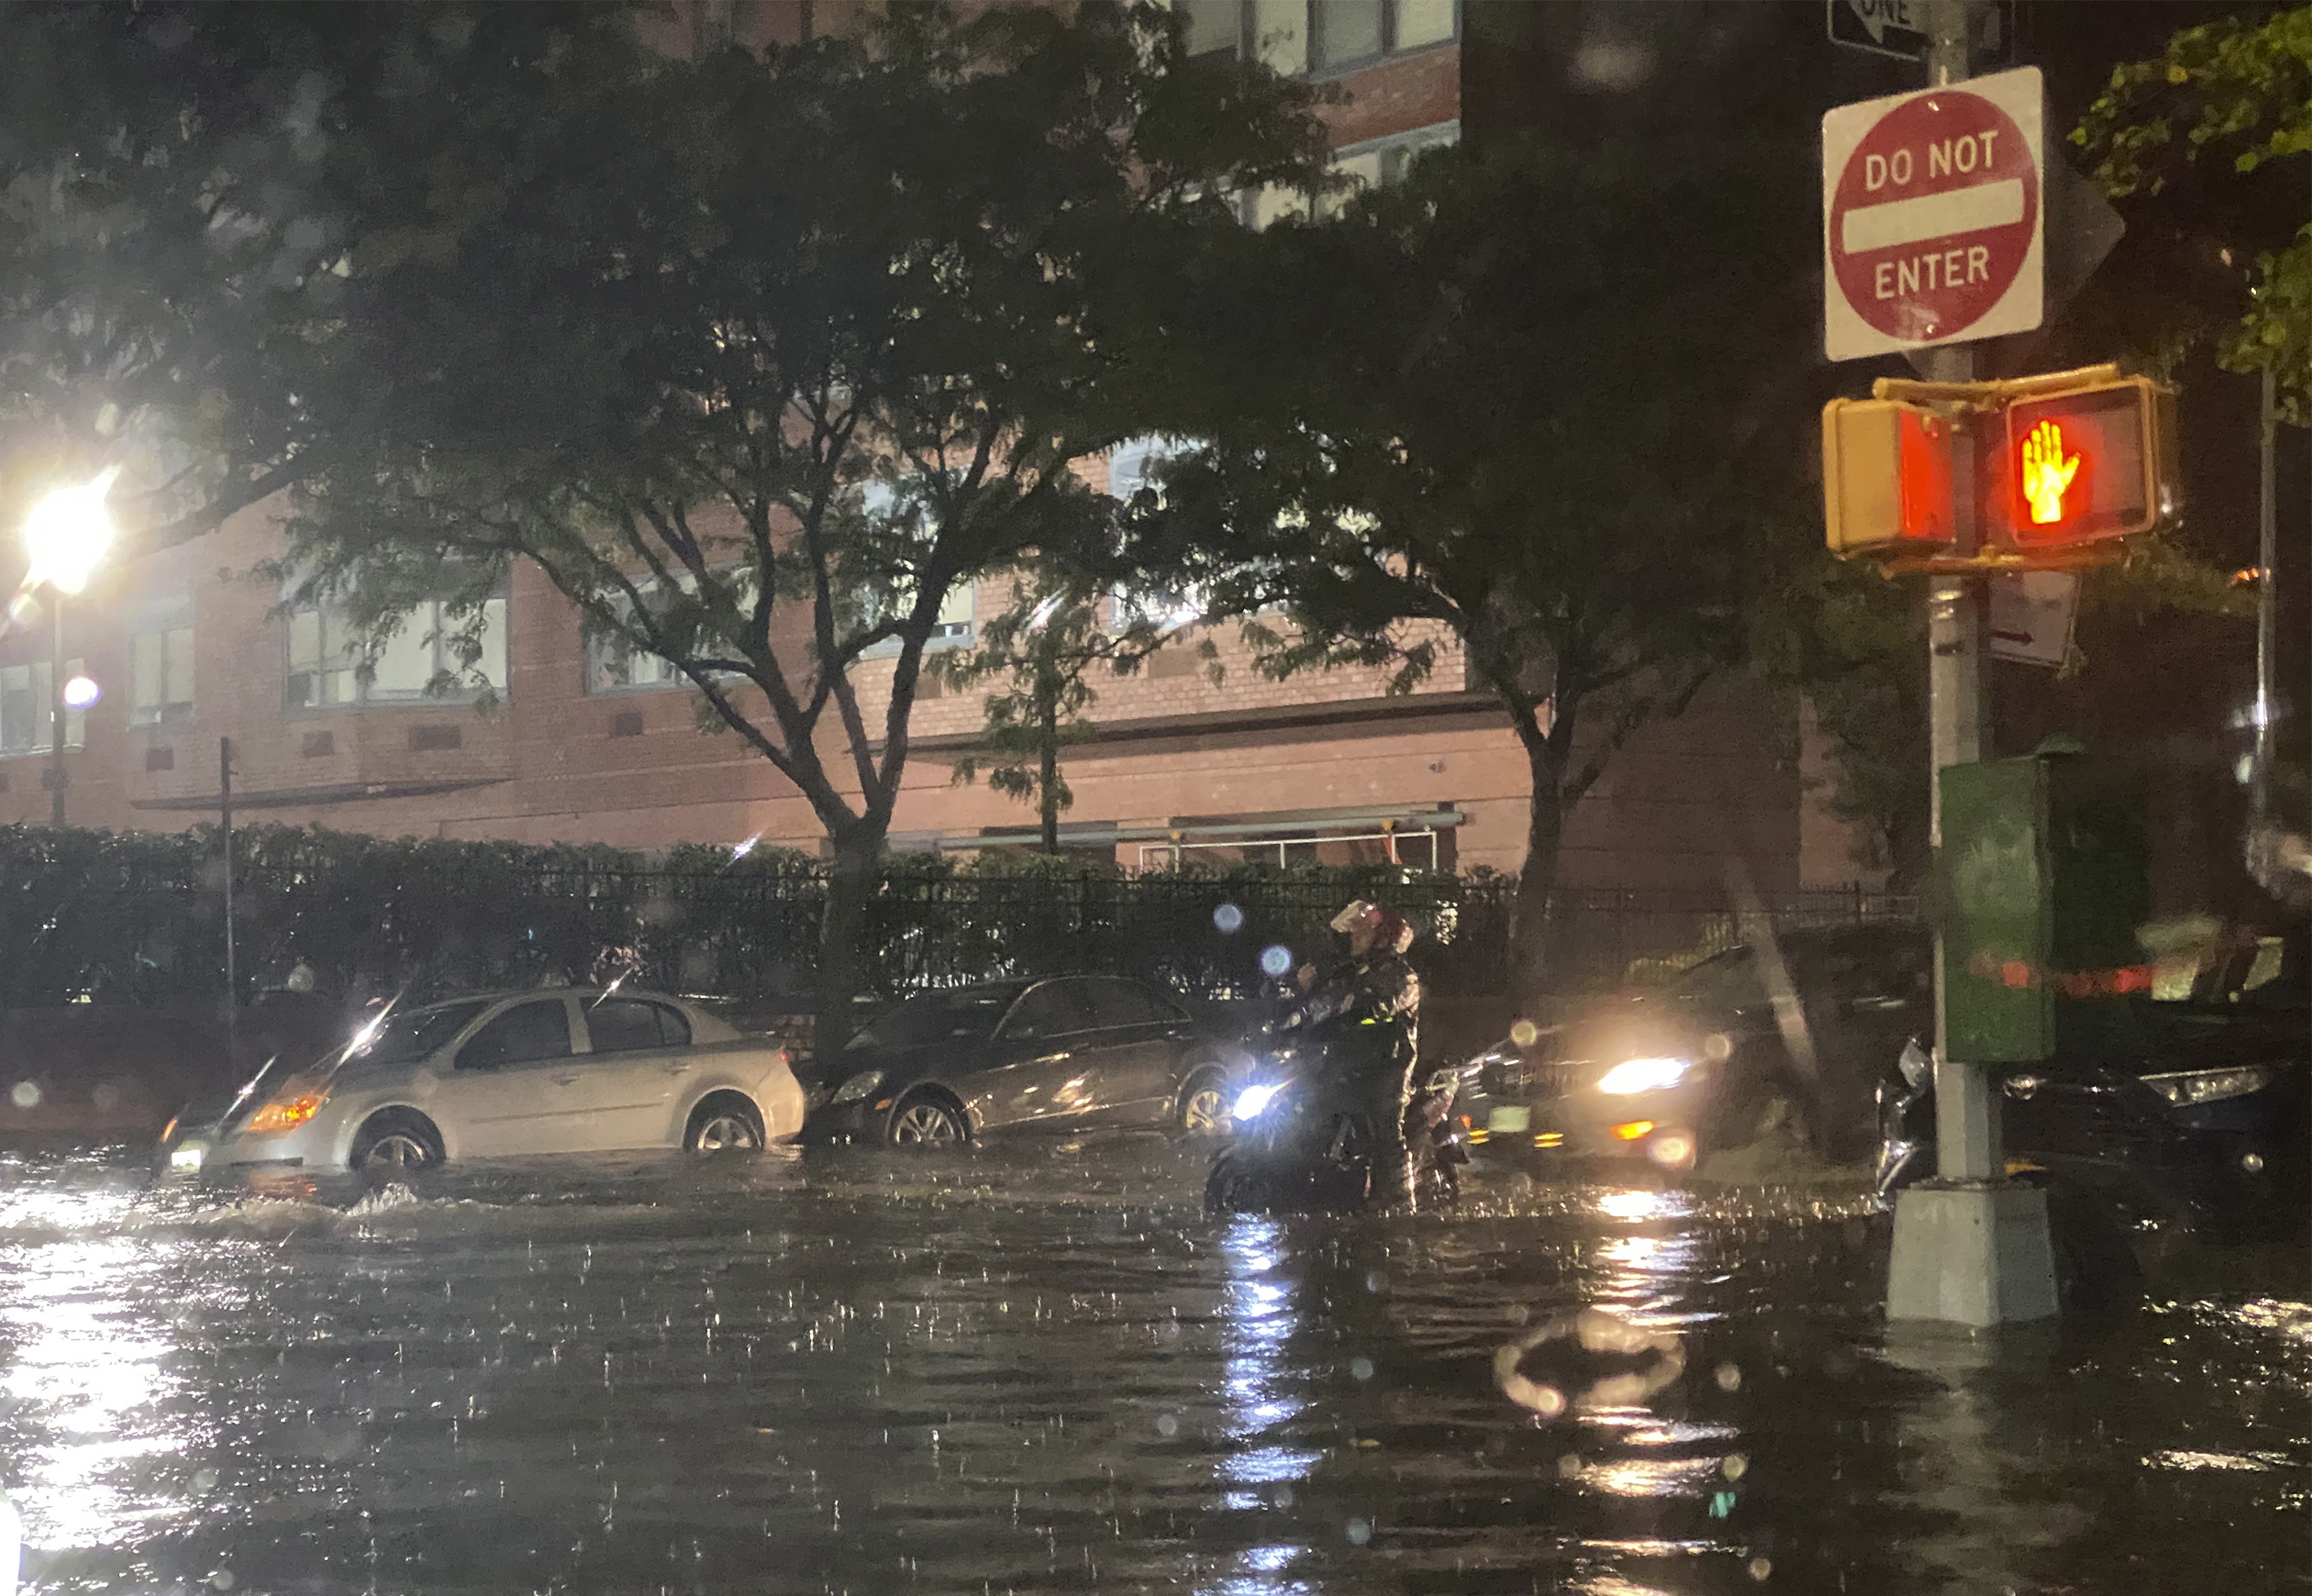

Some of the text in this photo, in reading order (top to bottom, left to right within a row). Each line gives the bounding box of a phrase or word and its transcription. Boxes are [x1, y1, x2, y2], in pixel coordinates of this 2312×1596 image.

[1865, 130, 1998, 192] DO NOT
[1875, 246, 1989, 300] ENTER
